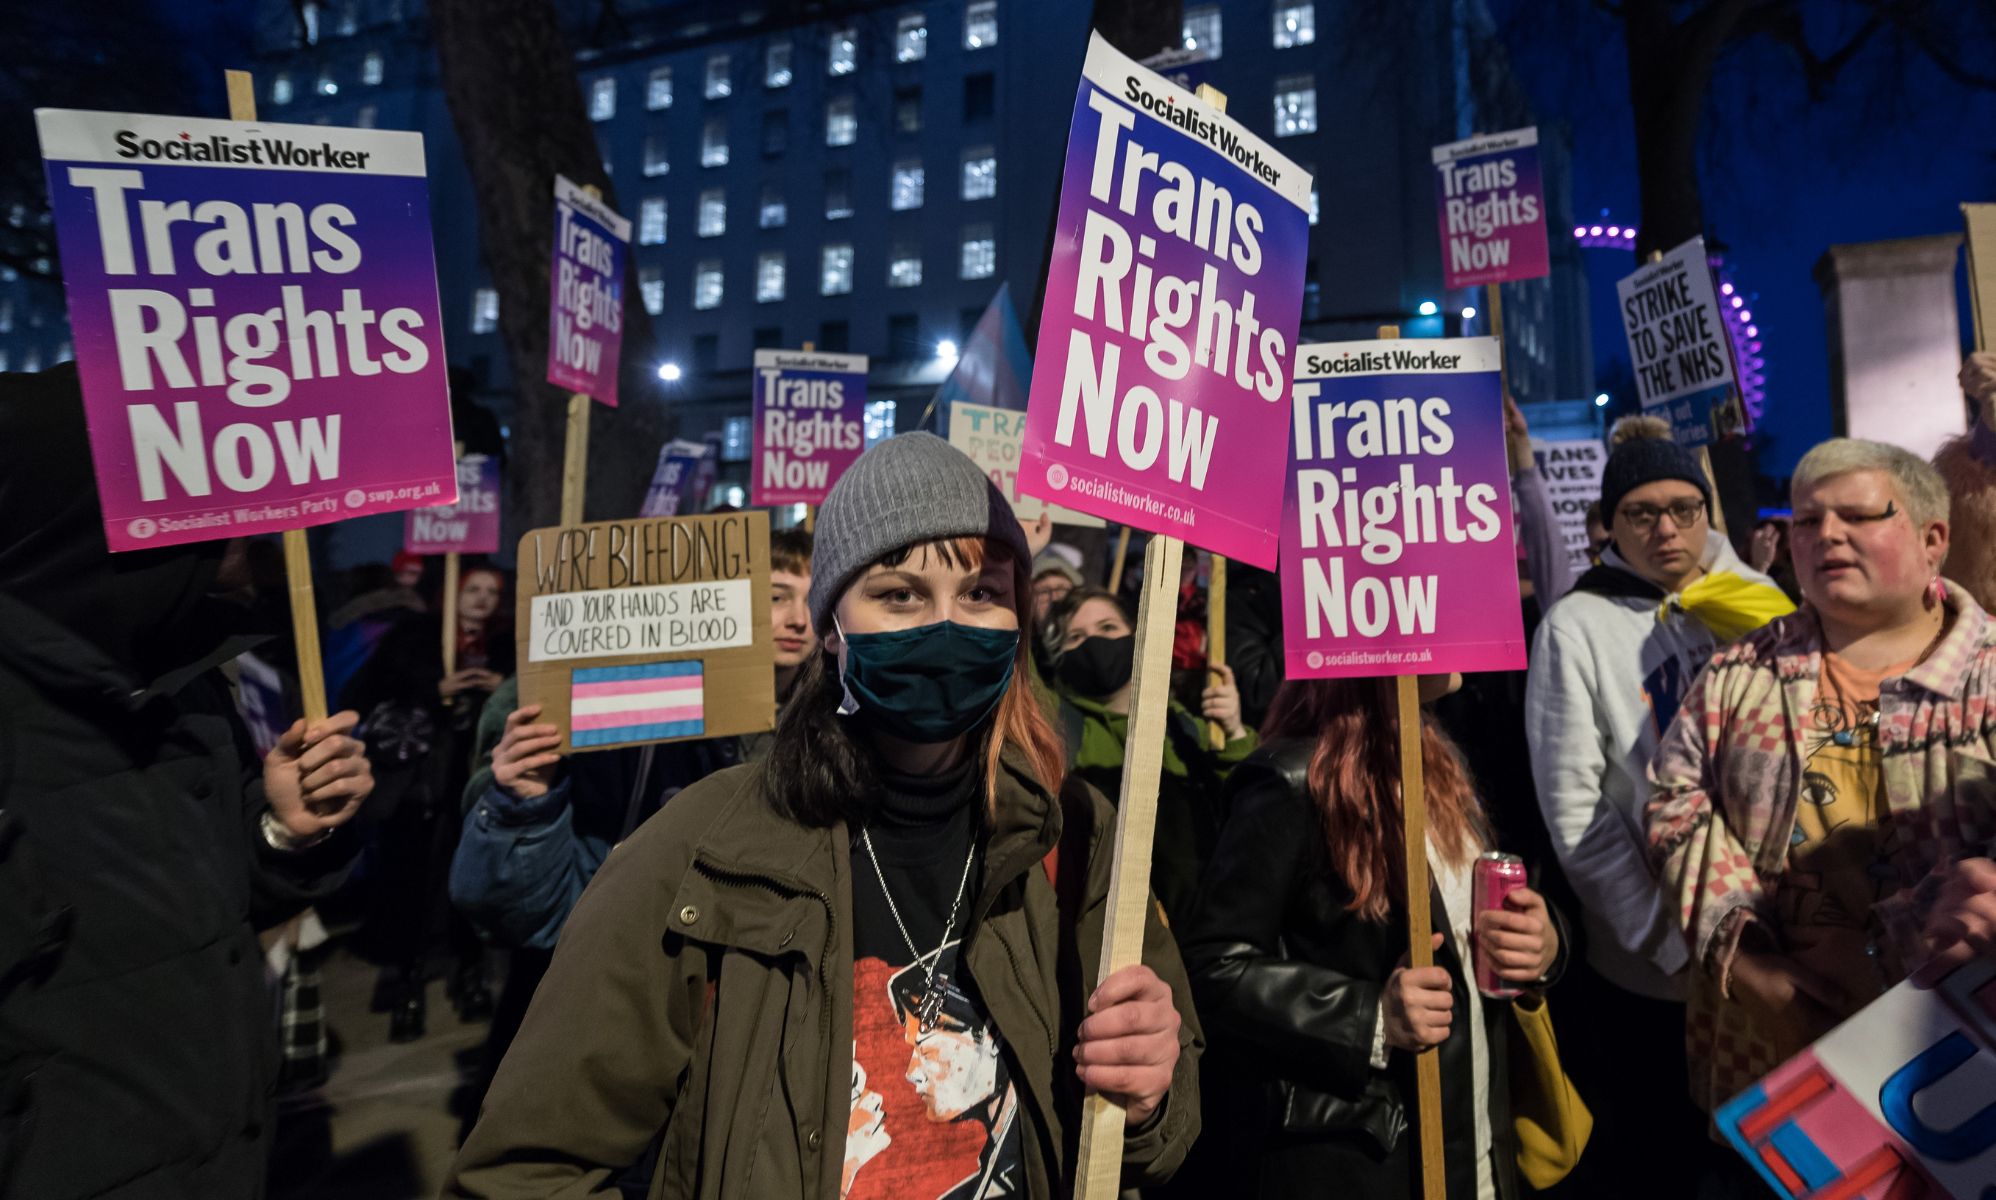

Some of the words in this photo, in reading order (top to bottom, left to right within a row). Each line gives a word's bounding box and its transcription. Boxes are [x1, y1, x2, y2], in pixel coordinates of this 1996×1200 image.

[1089, 89, 1264, 276] Trans
[1438, 159, 1517, 197] Trans
[68, 167, 362, 276] Trans
[557, 202, 613, 278] Trans
[1447, 189, 1540, 238] Rights
[1450, 236, 1510, 273] Now
[558, 257, 621, 334] Rights
[1073, 208, 1286, 402] Rights
[1625, 272, 1694, 329] STRIKE
[109, 285, 430, 408] Rights
[556, 312, 602, 376] Now
[1630, 328, 1657, 364] TO
[1660, 305, 1713, 354] SAVE
[760, 369, 844, 409] Trans
[1639, 359, 1676, 399] THE
[1678, 342, 1725, 386] NHS
[764, 409, 861, 457] Rights
[1054, 327, 1218, 491] Now
[1292, 382, 1454, 460] Trans
[127, 400, 341, 502] Now
[762, 451, 830, 489] Now
[969, 437, 1022, 462] PEO
[1550, 447, 1597, 462] ANS
[159, 511, 231, 533] Socialist
[234, 504, 298, 524] Workers
[302, 497, 338, 516] Party
[368, 483, 441, 502] swp.org.uk
[414, 515, 469, 542] Now
[1070, 477, 1195, 527] socialistworker.co.uk
[1297, 464, 1501, 565] Rights
[608, 517, 751, 589] BLEEDING!
[583, 593, 617, 623] YOUR
[620, 591, 679, 619] HANDS
[690, 588, 726, 615] ARE
[1302, 557, 1438, 639] Now
[544, 625, 631, 655] COVERED
[641, 622, 660, 648] IN
[670, 616, 737, 647] BLOOD
[1325, 648, 1433, 666] socialistworker.co.uk
